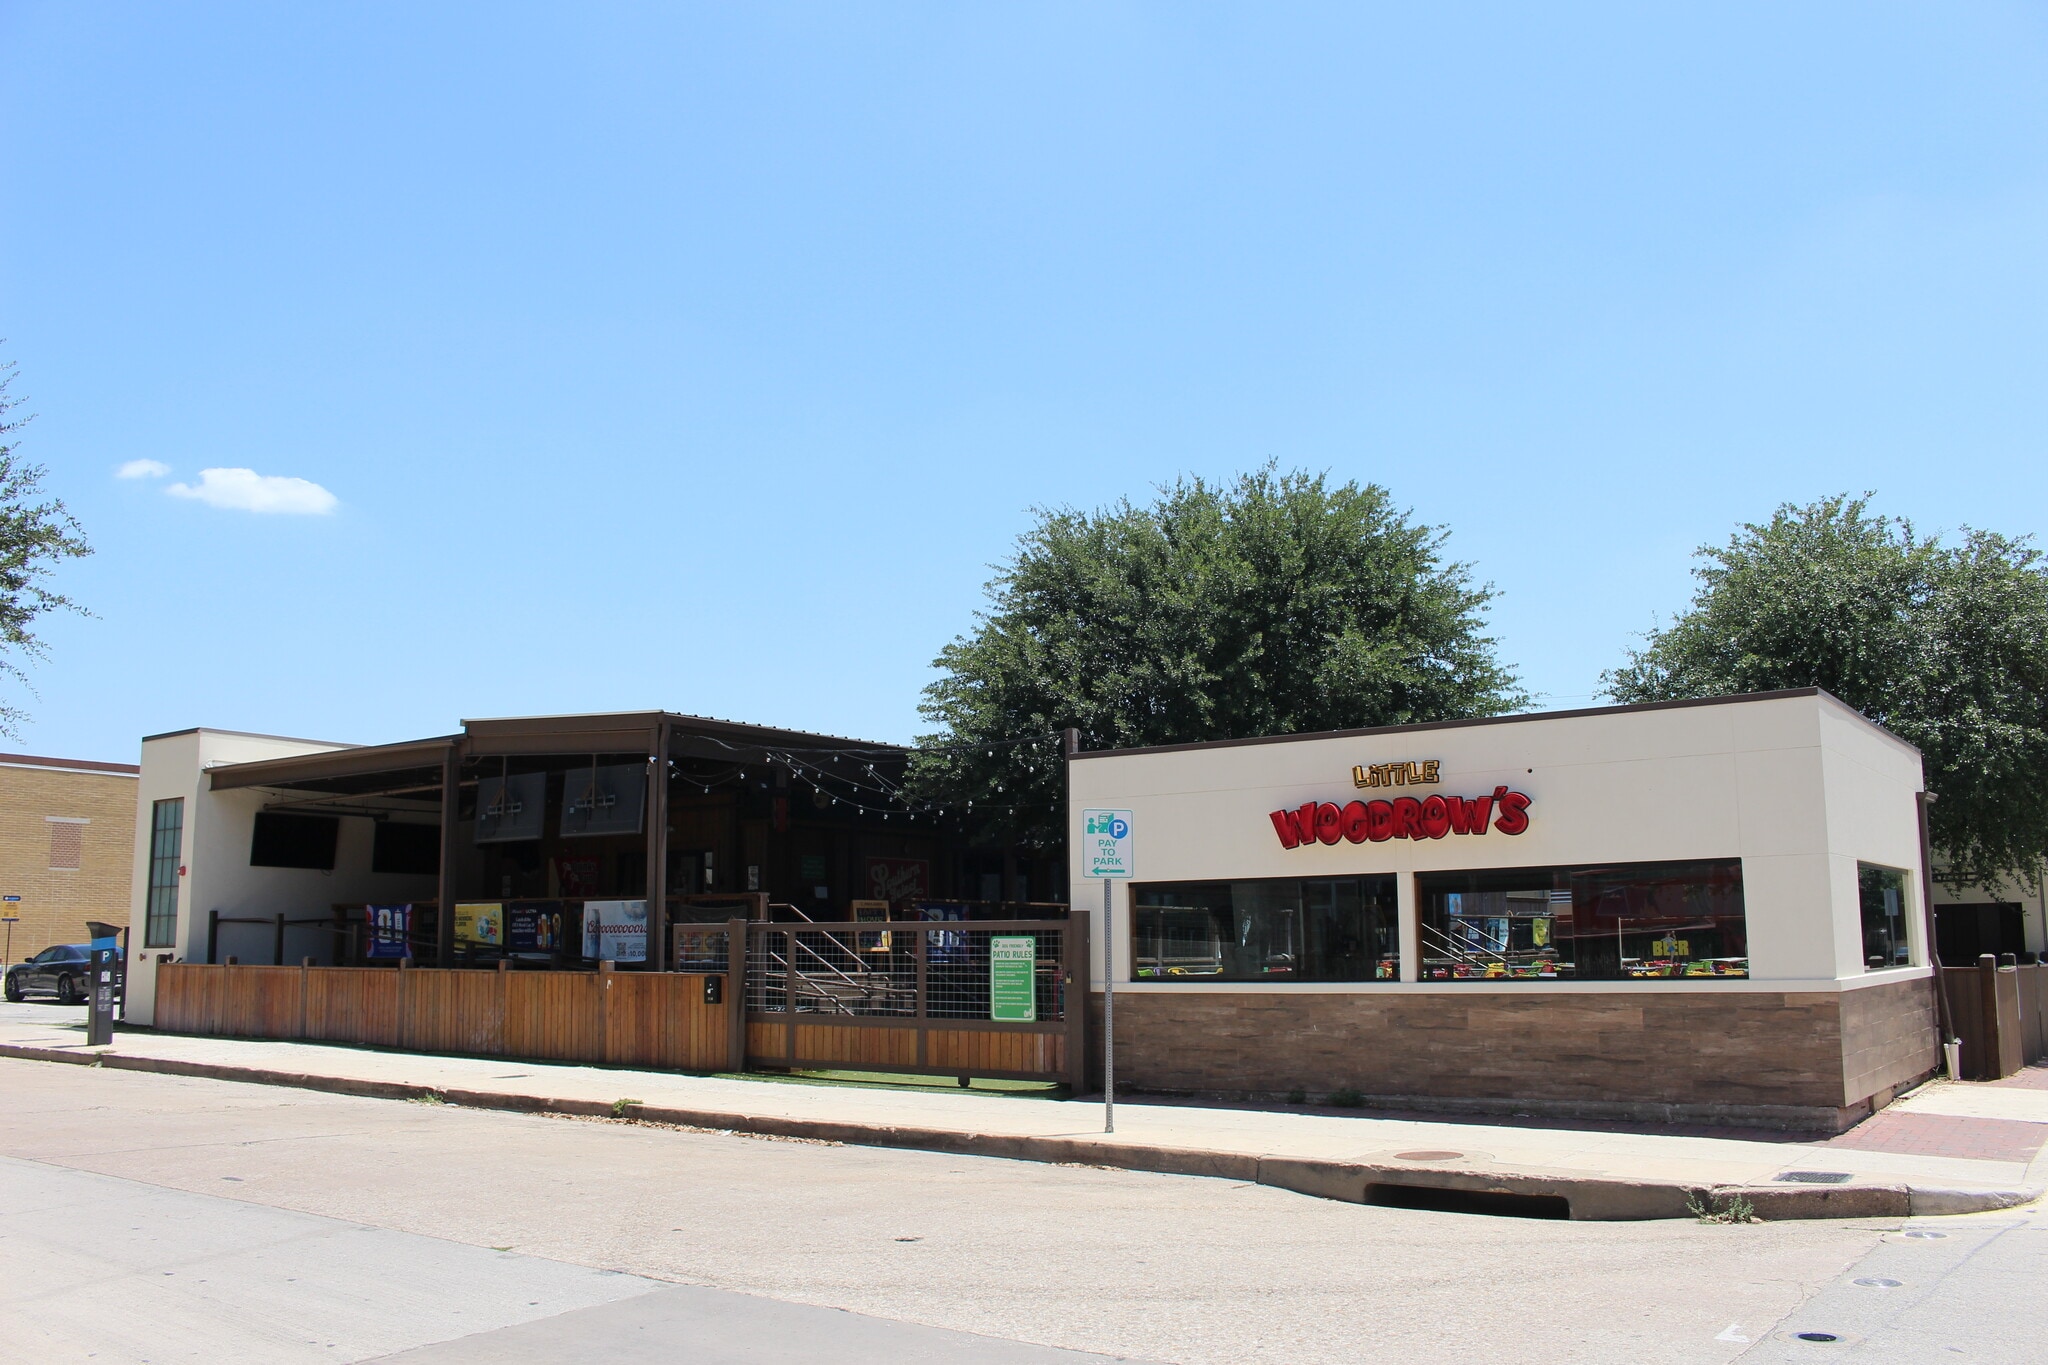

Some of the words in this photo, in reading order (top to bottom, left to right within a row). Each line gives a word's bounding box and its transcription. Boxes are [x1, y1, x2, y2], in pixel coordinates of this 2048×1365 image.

[1269, 786, 1532, 850] WOODROW'S
[1113, 822, 1125, 837] P
[1098, 839, 1117, 847] PAY
[1101, 848, 1115, 856] TO
[1093, 857, 1122, 865] PARK
[992, 950, 1010, 959] PATIO
[1012, 950, 1033, 959] RULES
